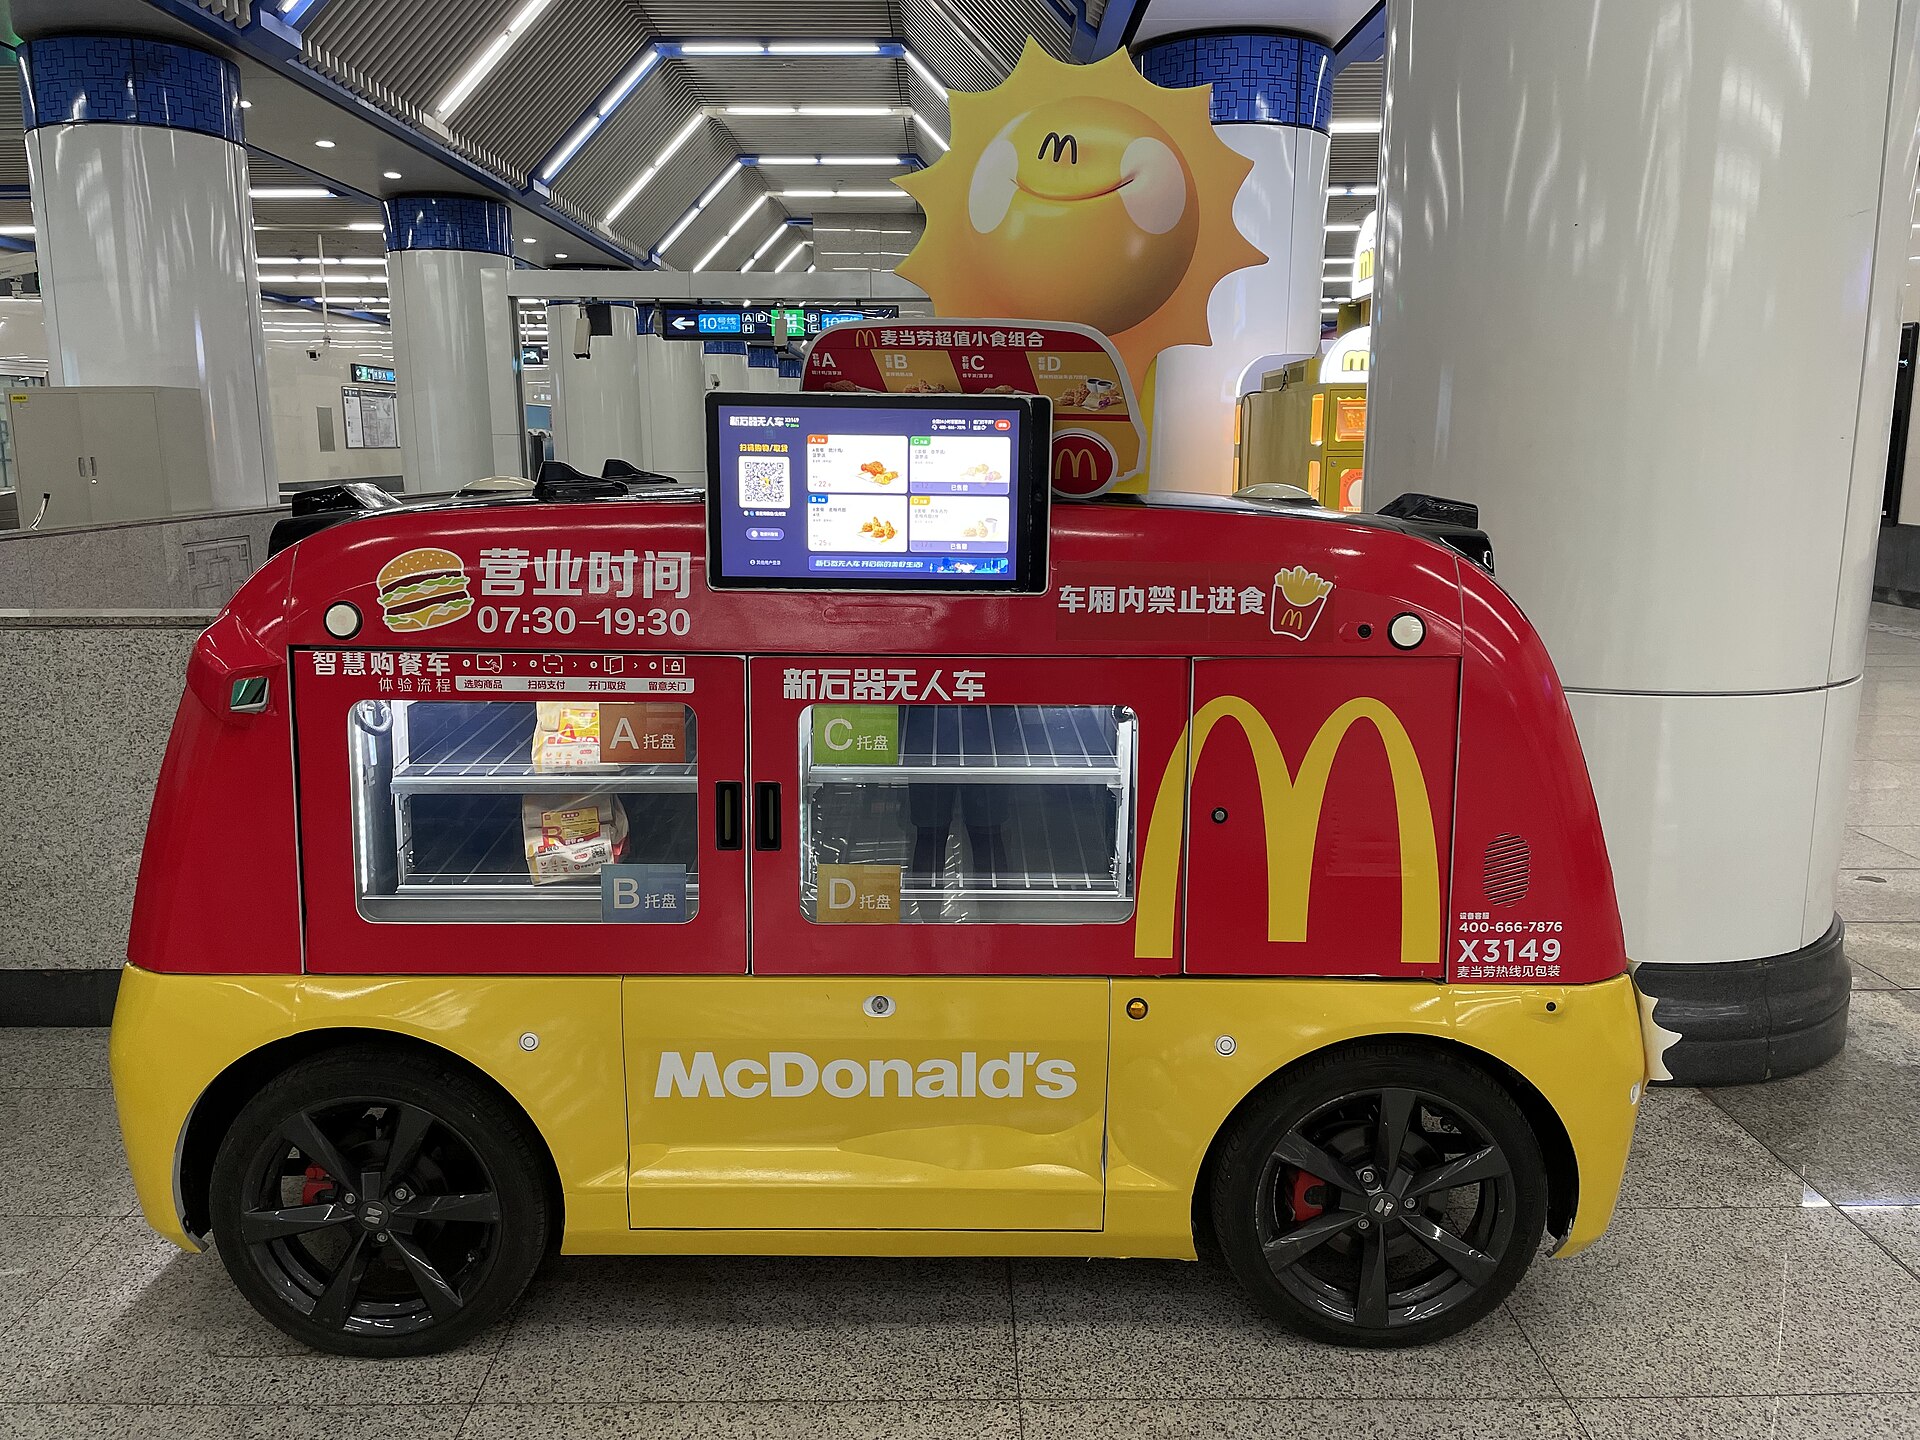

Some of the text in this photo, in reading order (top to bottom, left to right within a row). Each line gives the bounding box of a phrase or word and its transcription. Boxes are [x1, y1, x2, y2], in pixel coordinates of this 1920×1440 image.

[700, 316, 736, 330] 10号线
[744, 314, 766, 322] A D
[880, 330, 1044, 348] 麦当劳超值小食组合
[822, 352, 836, 368] A
[894, 354, 908, 369] B
[970, 355, 985, 370] C
[1047, 356, 1061, 372] D
[730, 416, 784, 426] 新石器无人车
[478, 548, 692, 599] 营业时间
[1058, 586, 1266, 614] 车厢内禁止进食
[313, 652, 450, 676] 智慧购餐车
[378, 678, 452, 692] 体验流程
[464, 680, 502, 689] 选购商品
[528, 680, 566, 690] 扫码支付
[588, 680, 626, 690] 开门取货
[648, 682, 686, 691] 留意关门
[783, 668, 986, 701] 新石器无人车
[609, 718, 640, 750] A
[643, 734, 676, 750] 托盘
[824, 718, 889, 751] C 托盘
[613, 878, 676, 909] B 托盘
[829, 878, 891, 910] D 托盘
[1459, 922, 1562, 933] 400-666-7876
[1457, 938, 1561, 962] X3149
[1457, 965, 1561, 978] 麦当劳热线见包装
[654, 1052, 1078, 1098] McDonald's
